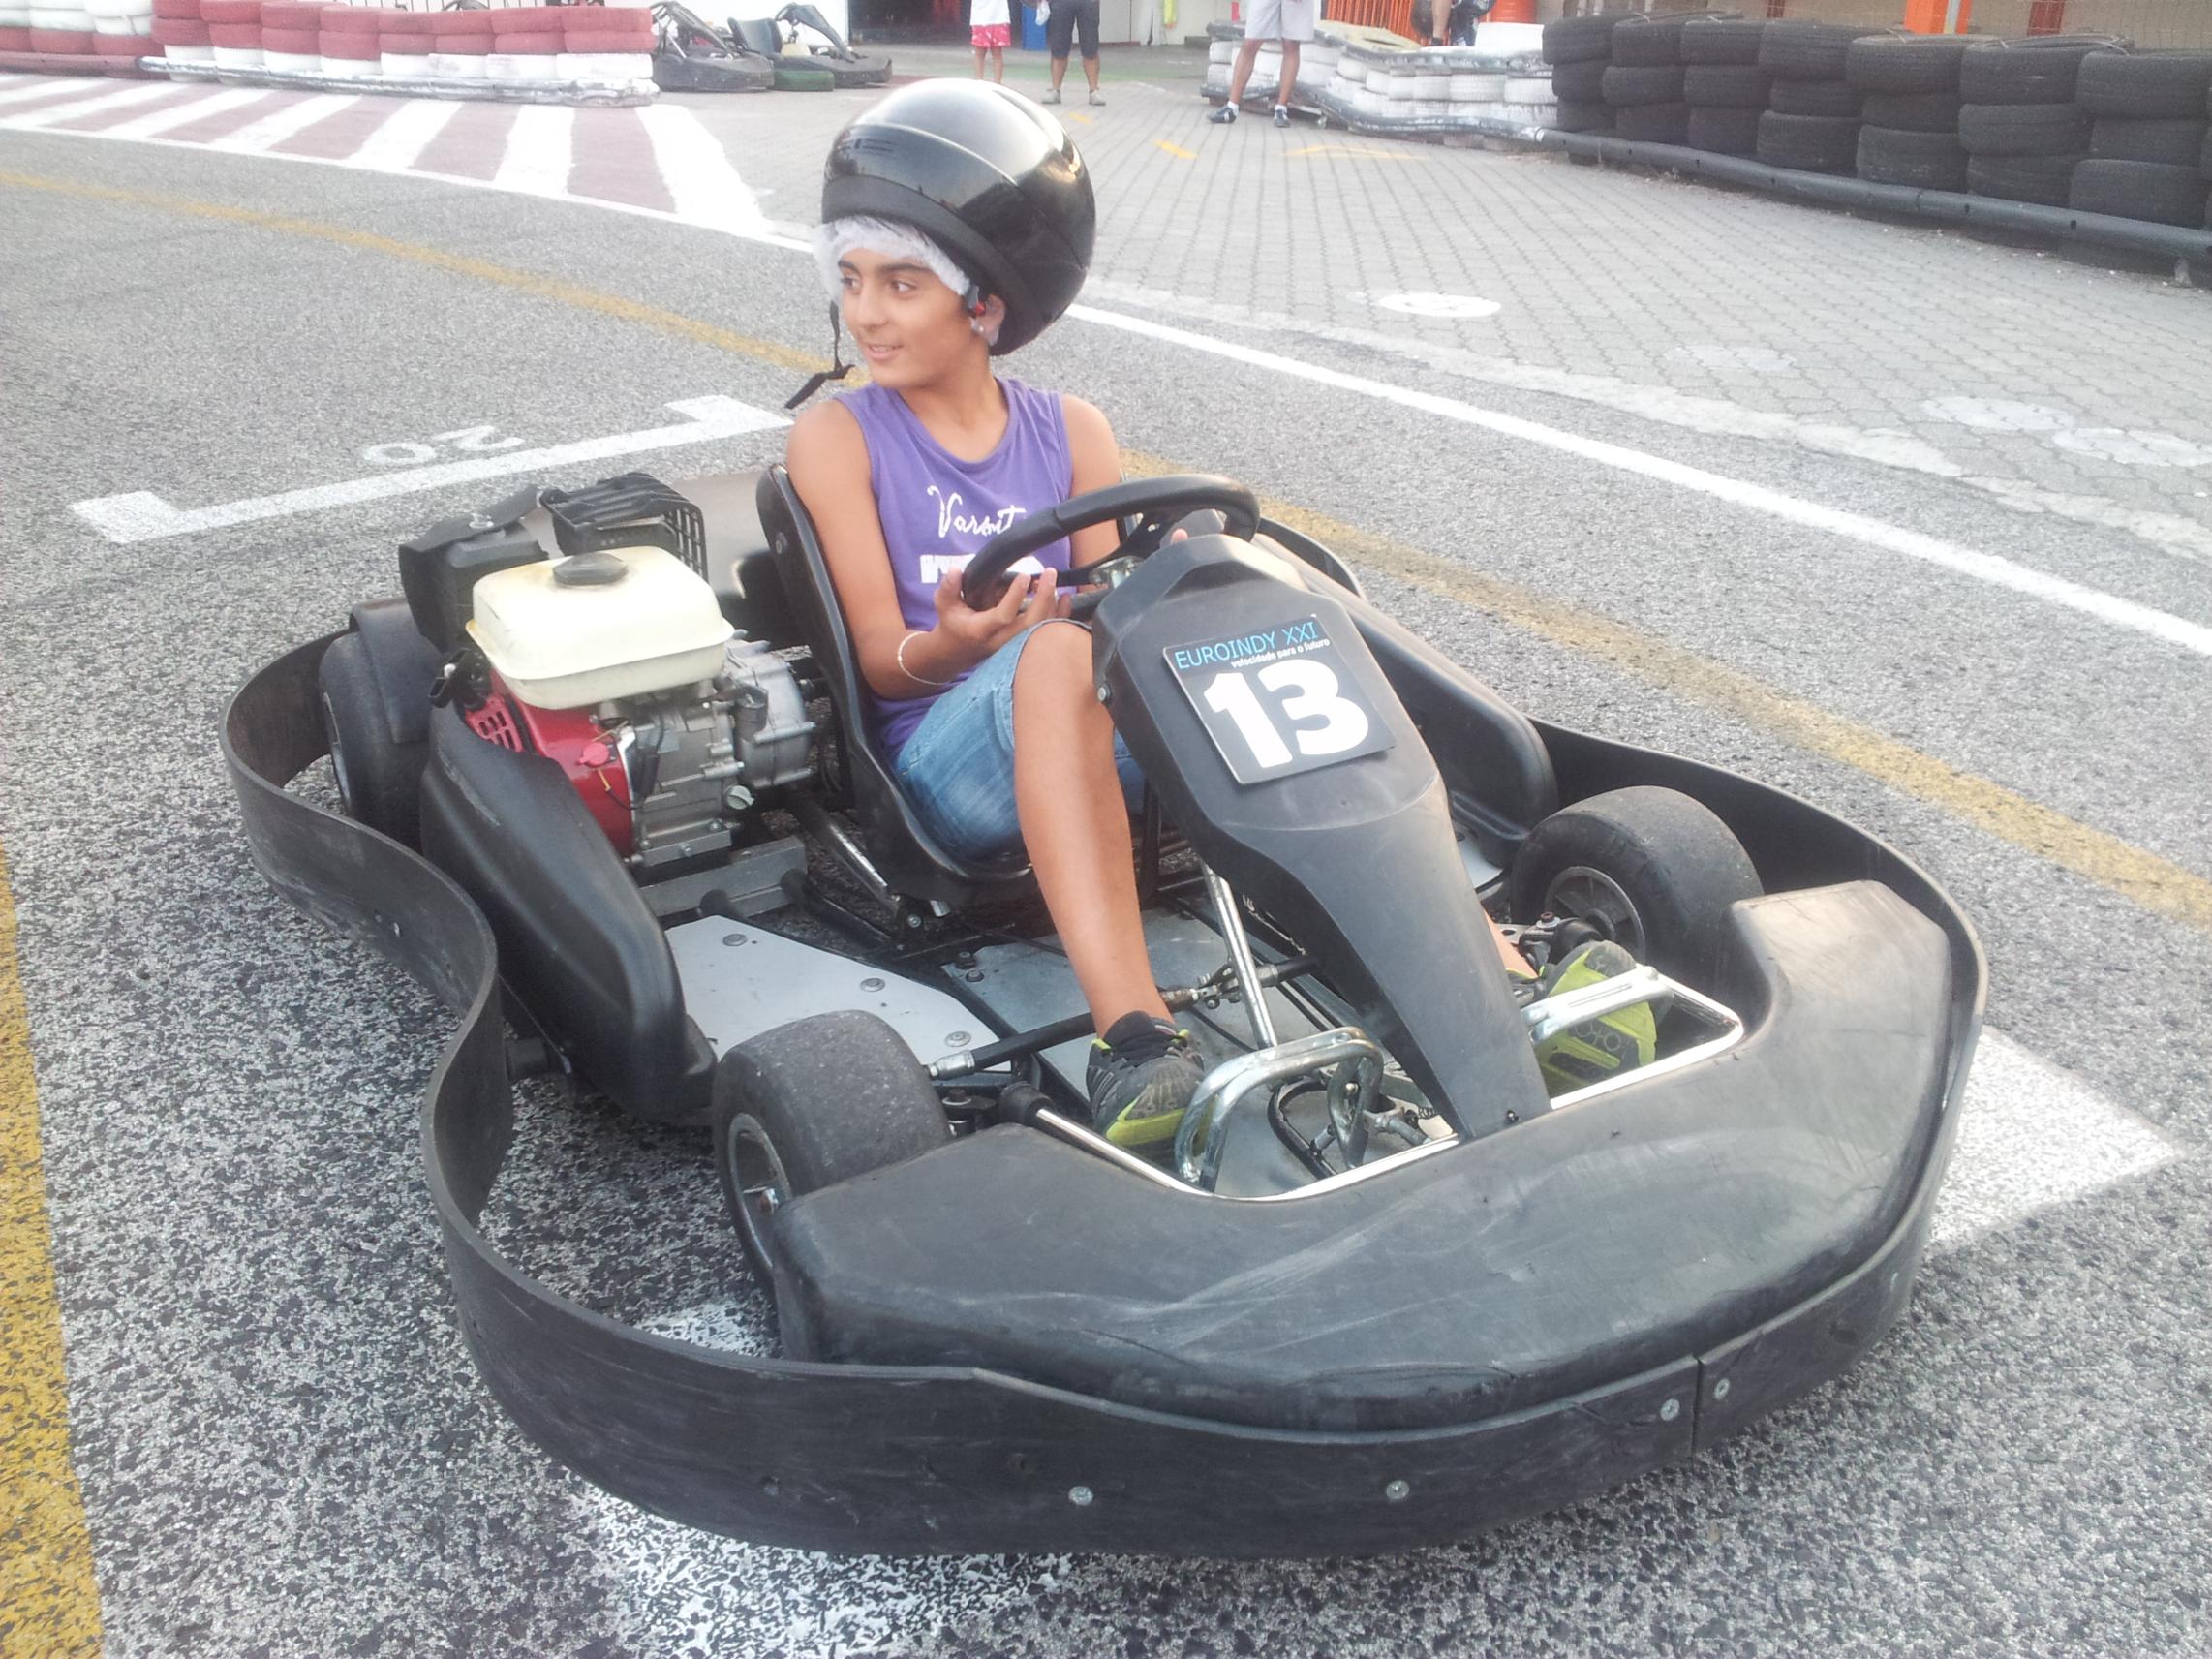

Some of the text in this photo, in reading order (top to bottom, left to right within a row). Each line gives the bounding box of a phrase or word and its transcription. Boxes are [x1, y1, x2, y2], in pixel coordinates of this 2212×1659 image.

[927, 485, 1027, 538] Varsit
[1174, 621, 1318, 670] EUROINDY XXI
[1277, 647, 1296, 658] para
[1304, 638, 1330, 651] futuro
[1203, 659, 1369, 768] 13
